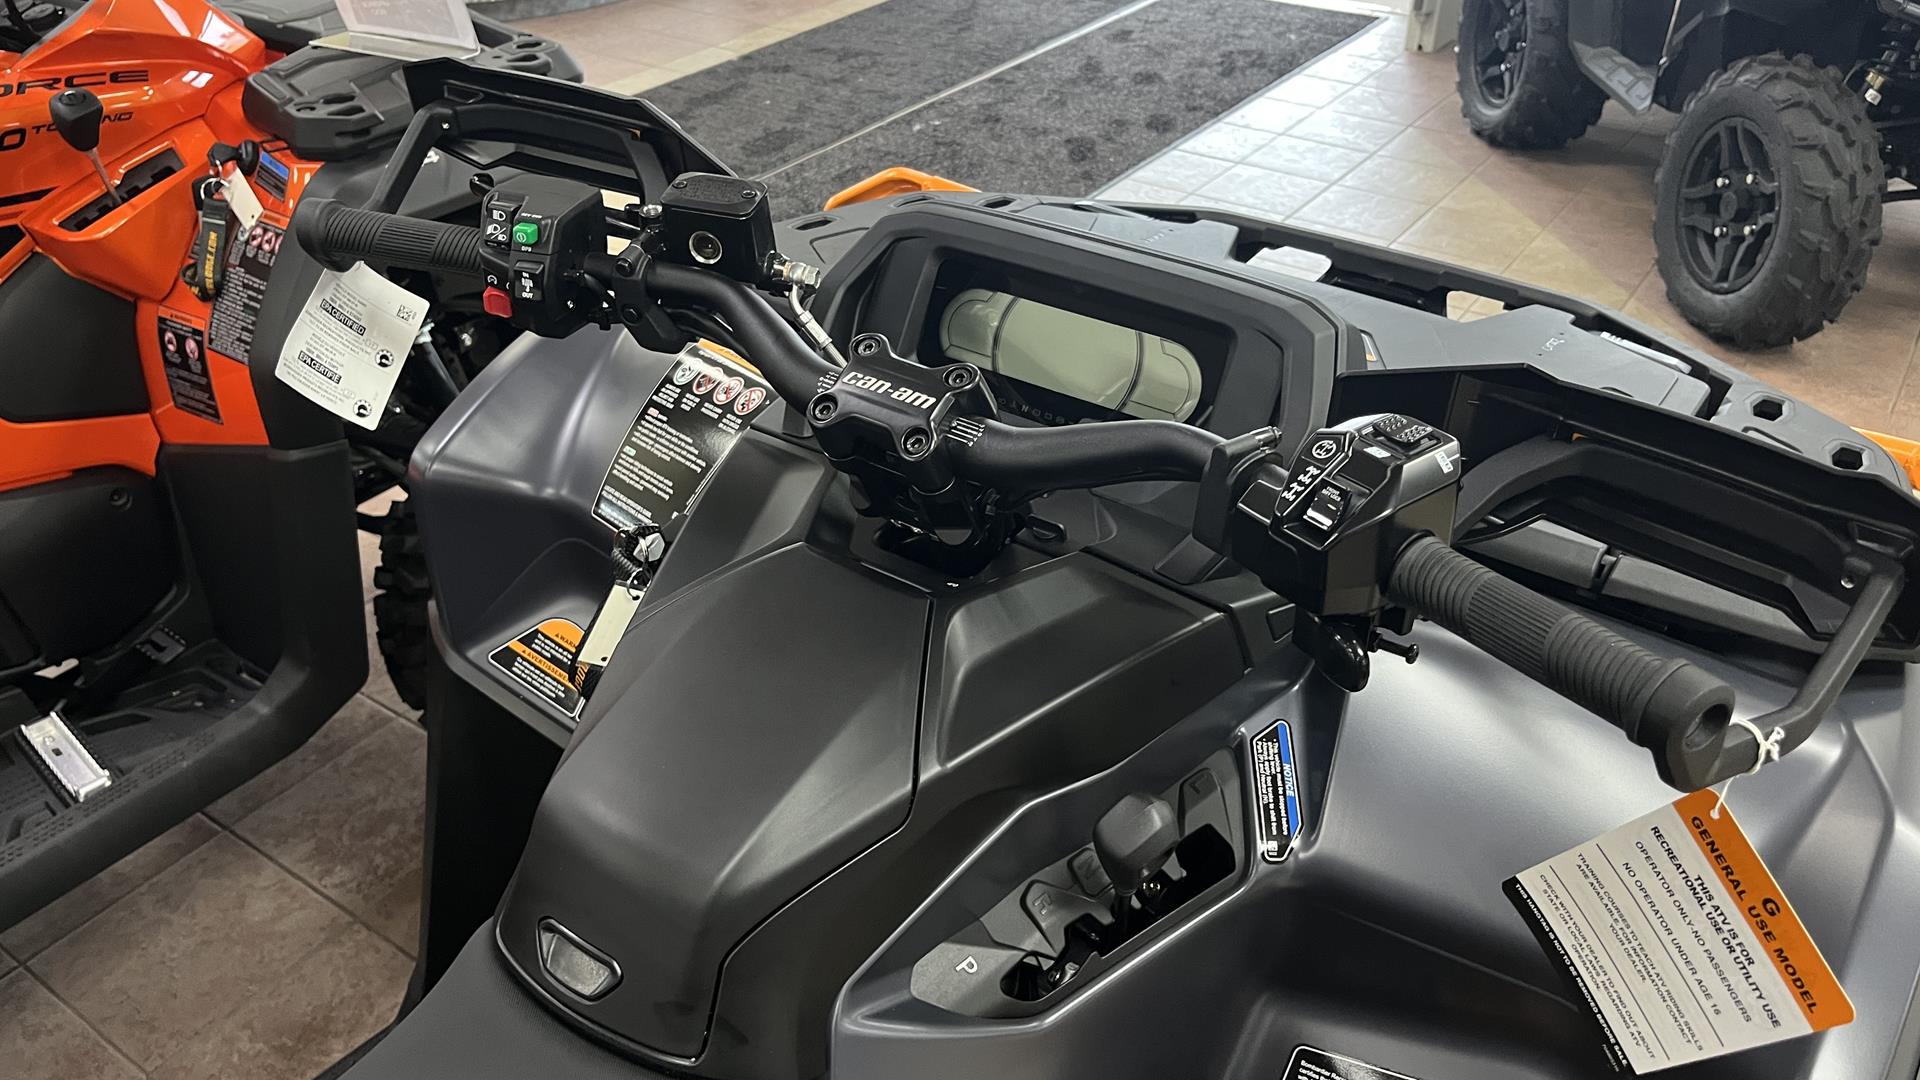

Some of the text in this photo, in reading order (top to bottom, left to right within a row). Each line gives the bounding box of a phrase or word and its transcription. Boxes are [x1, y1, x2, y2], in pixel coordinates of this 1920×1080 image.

[322, 302, 332, 313] EPA
[330, 307, 365, 334] CERTIFIED
[299, 352, 312, 364] EPA
[842, 371, 937, 409] can-am
[527, 650, 569, 683] AVERTISSEME
[1283, 763, 1295, 798] NOTICE
[1514, 883, 1528, 899] THIS
[1758, 895, 1783, 918] G
[1524, 898, 1550, 932] HANGTAG
[1649, 825, 1782, 1028] RECREATIONAL USE OR UTILITY USE
[1688, 814, 1821, 1014] GENERAL USE MODEL
[1691, 874, 1756, 966] THIS ATV IS FOR
[1547, 931, 1556, 939] IS
[1551, 939, 1566, 955] NOT
[1607, 922, 1626, 946] YOUR
[1620, 861, 1722, 1016] NO OPERATOR UNDER AGE 16
[1633, 840, 1753, 1023] OPERATOR ONLY-NO PASSENGERS
[955, 955, 978, 975] P
[1538, 873, 1656, 1059] CHECK WITH YOUR DEALER TO FIND OUT ABOUT
[1541, 888, 1561, 912] STATE
[1557, 912, 1569, 925] OR
[1566, 926, 1587, 954] LOCAL
[1599, 979, 1632, 1029] REGARDING
[1628, 1030, 1643, 1048] ATV
[1561, 954, 1572, 965] TO
[1575, 863, 1590, 880] ARE
[1617, 926, 1633, 945] FOR
[1629, 944, 1667, 1003] INFORMATION
[1664, 1003, 1692, 1044] CONTACT
[1576, 852, 1704, 1051] TRAINING COURSES TO TEACH ATV RIDING SKILLS
[1567, 965, 1579, 976] BE
[1574, 976, 1600, 1013] REMOVED
[1595, 1012, 1617, 1044] BEFORE
